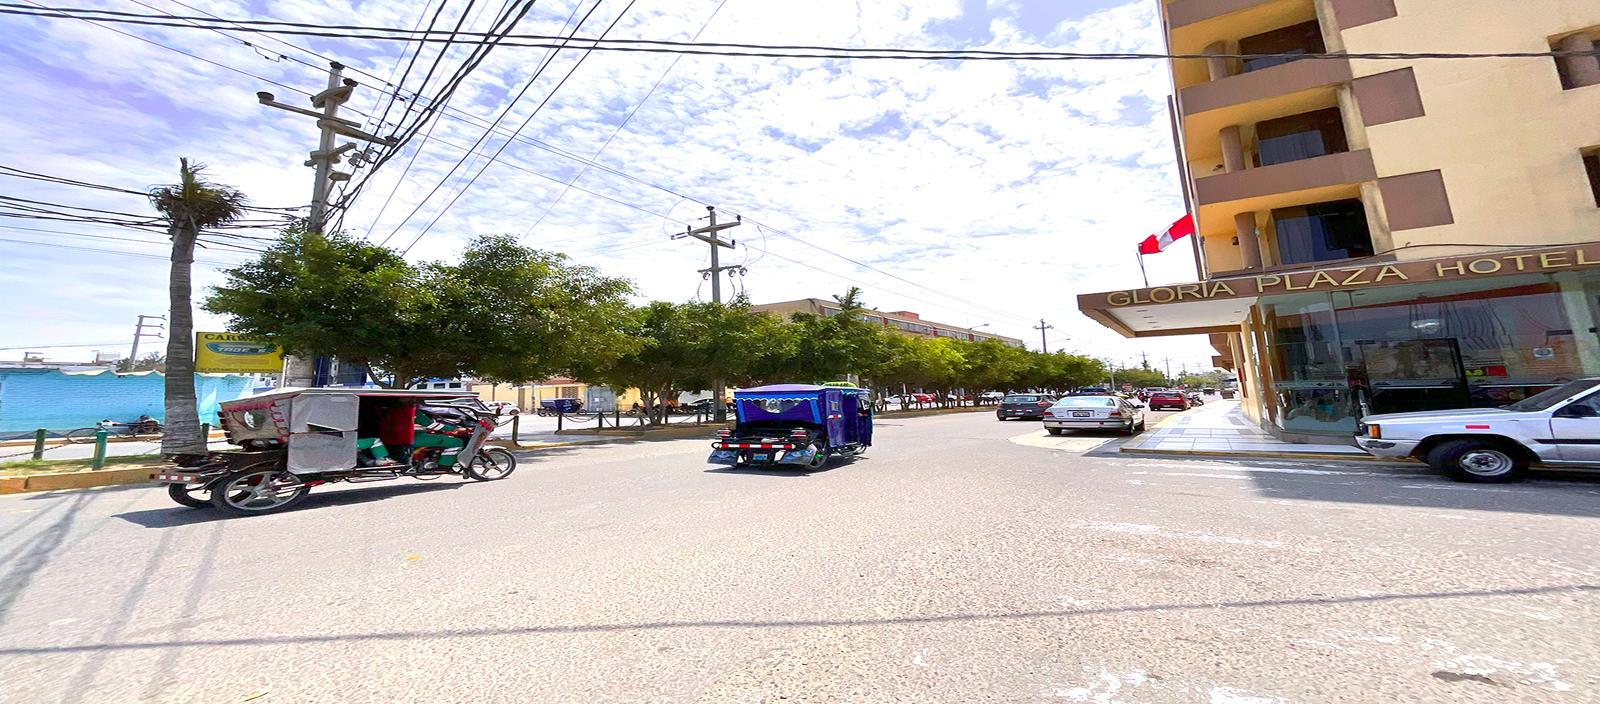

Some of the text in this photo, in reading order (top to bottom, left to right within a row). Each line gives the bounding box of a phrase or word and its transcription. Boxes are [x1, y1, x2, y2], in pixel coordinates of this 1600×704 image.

[1107, 249, 1600, 306] GLORIA PLAZA HOTEL
